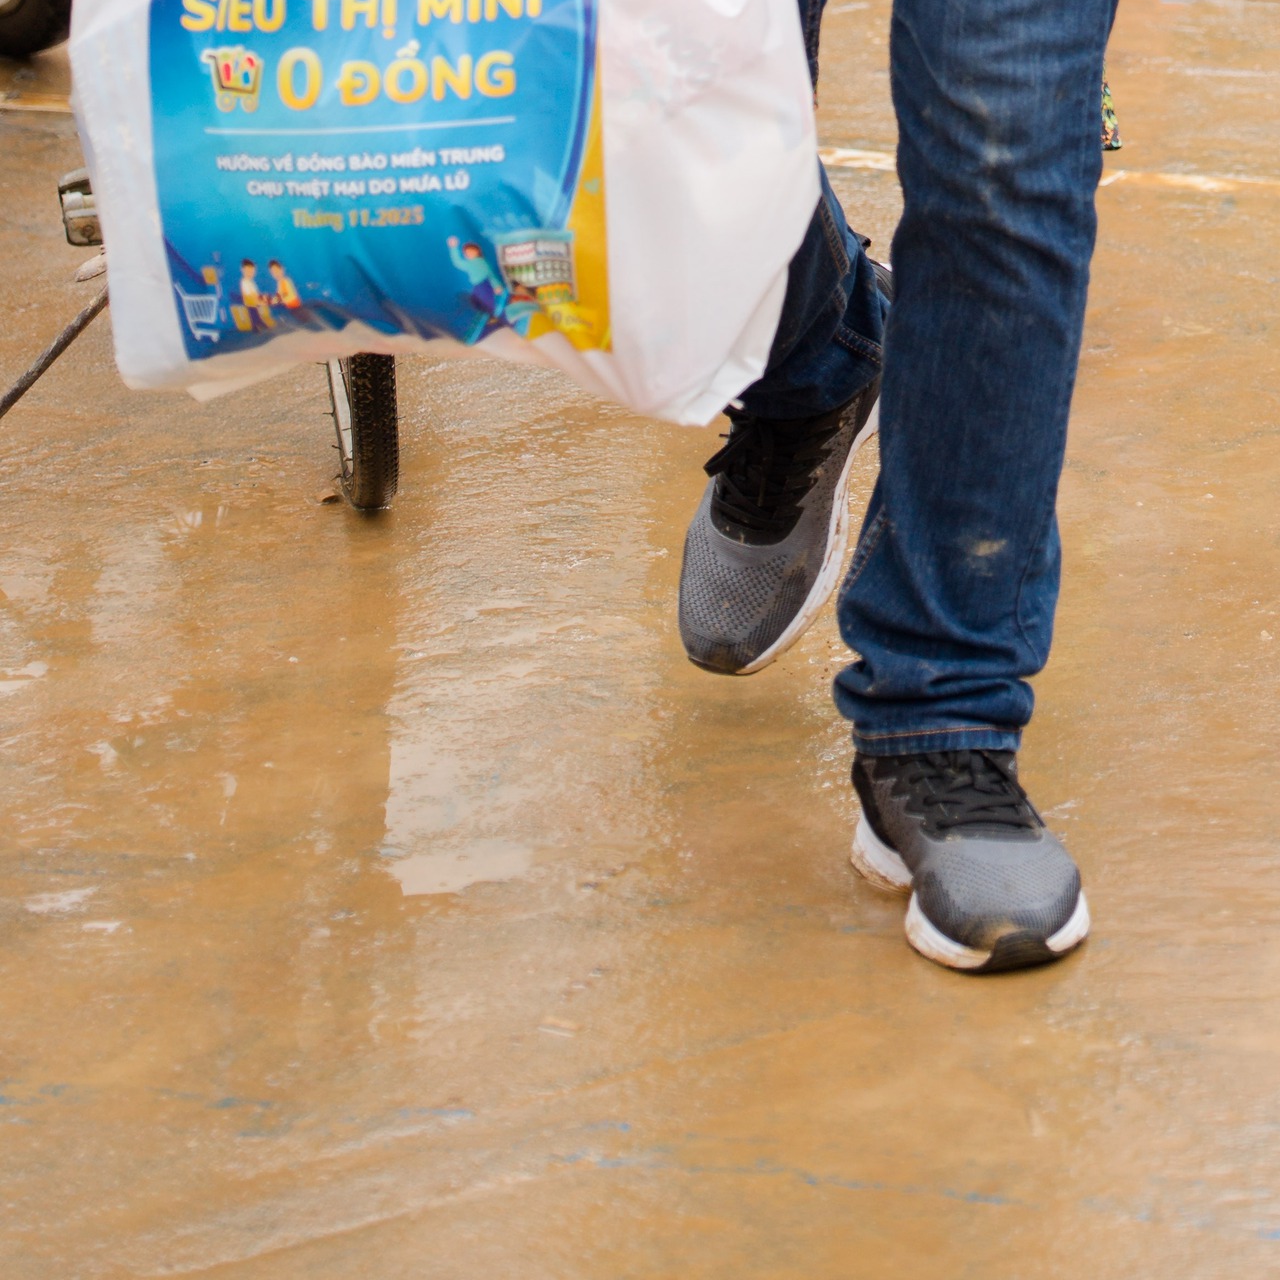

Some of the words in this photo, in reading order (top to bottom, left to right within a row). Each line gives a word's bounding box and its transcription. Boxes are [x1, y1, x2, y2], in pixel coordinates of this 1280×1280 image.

[276, 46, 323, 107] 0
[334, 37, 518, 107] ĐỒNG
[438, 143, 506, 166] TRUNG
[368, 177, 397, 195] DO
